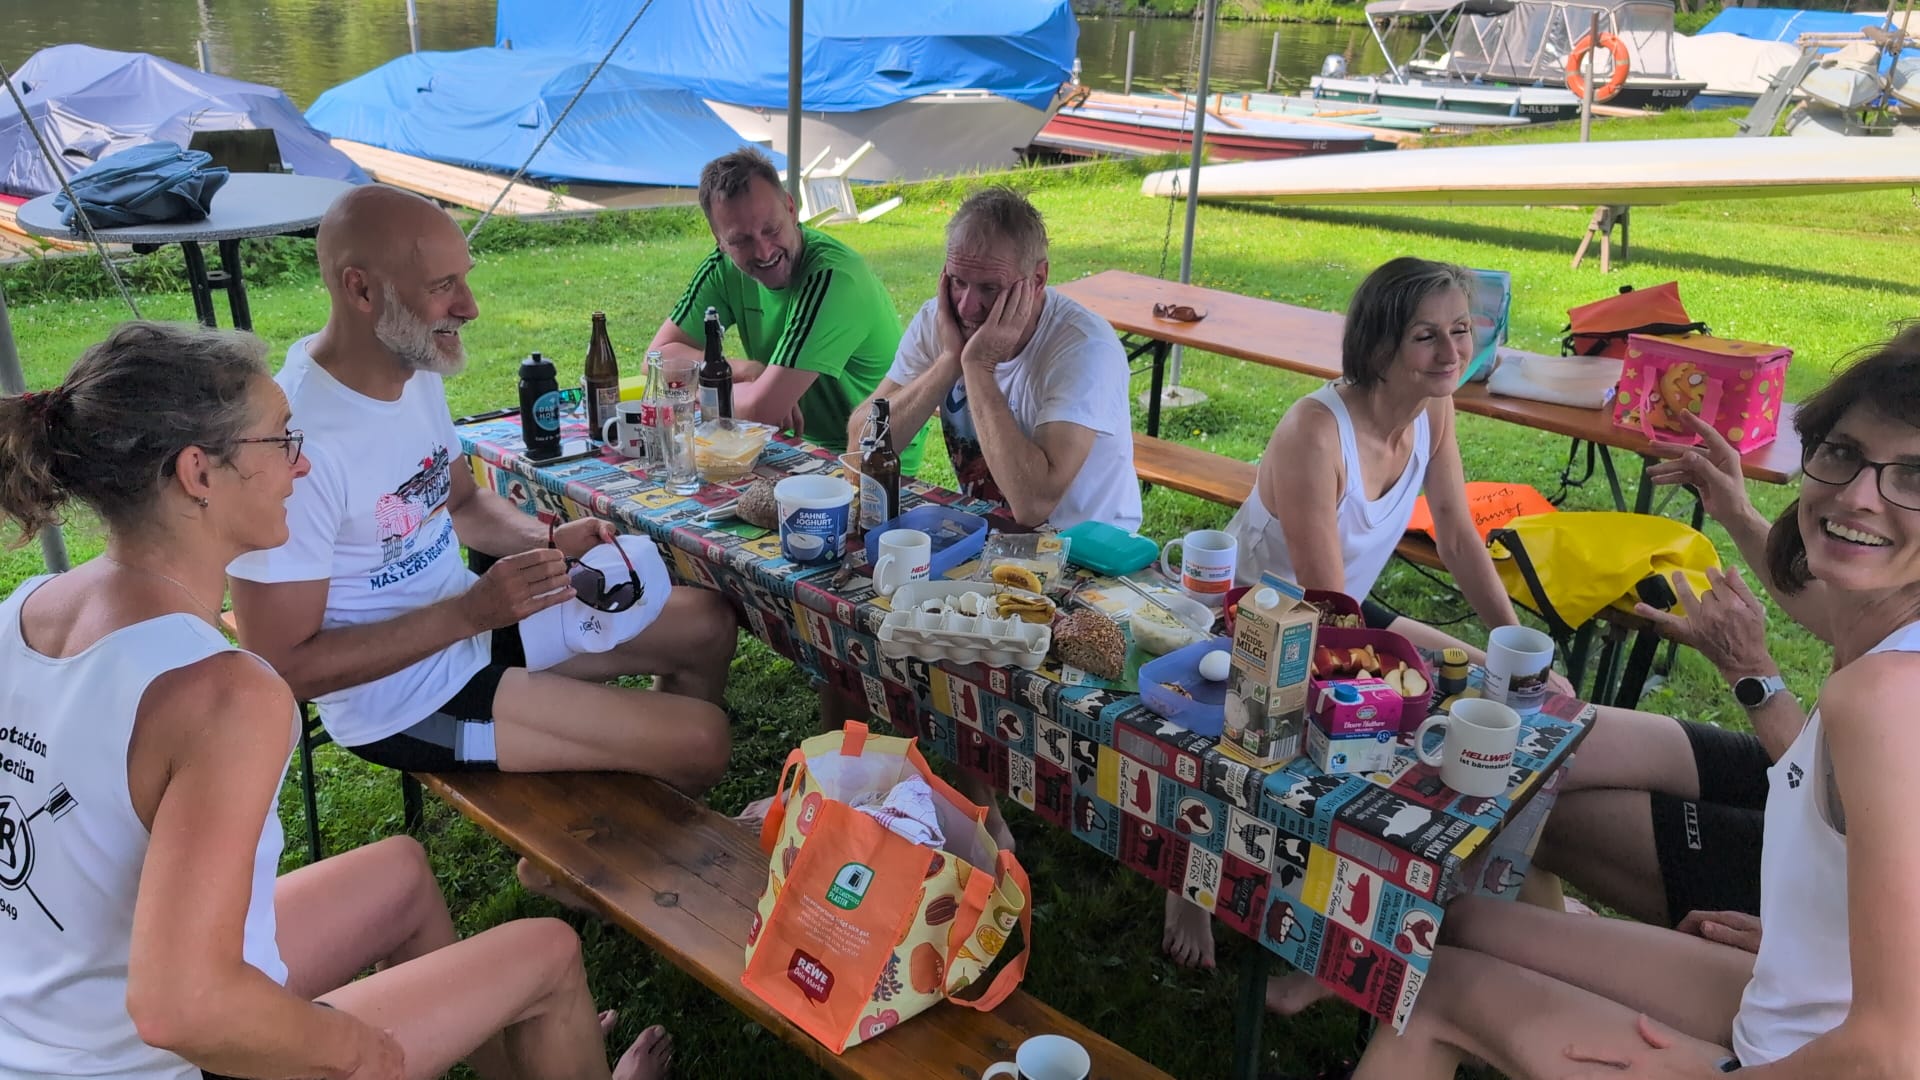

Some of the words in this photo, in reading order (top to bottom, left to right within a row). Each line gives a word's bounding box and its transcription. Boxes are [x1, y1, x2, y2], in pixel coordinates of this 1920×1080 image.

[796, 518, 832, 526] JOGHURT
[799, 512, 830, 520] SAHNE-
[370, 559, 428, 591] MASTERS
[1240, 630, 1264, 648] WEIDE-
[1236, 638, 1267, 661] MILCH
[1460, 757, 1470, 765] ist
[1189, 847, 1202, 881] EGGS
[798, 957, 829, 985] REWE
[805, 978, 825, 993] Markt
[1402, 970, 1421, 1007] EGGS
